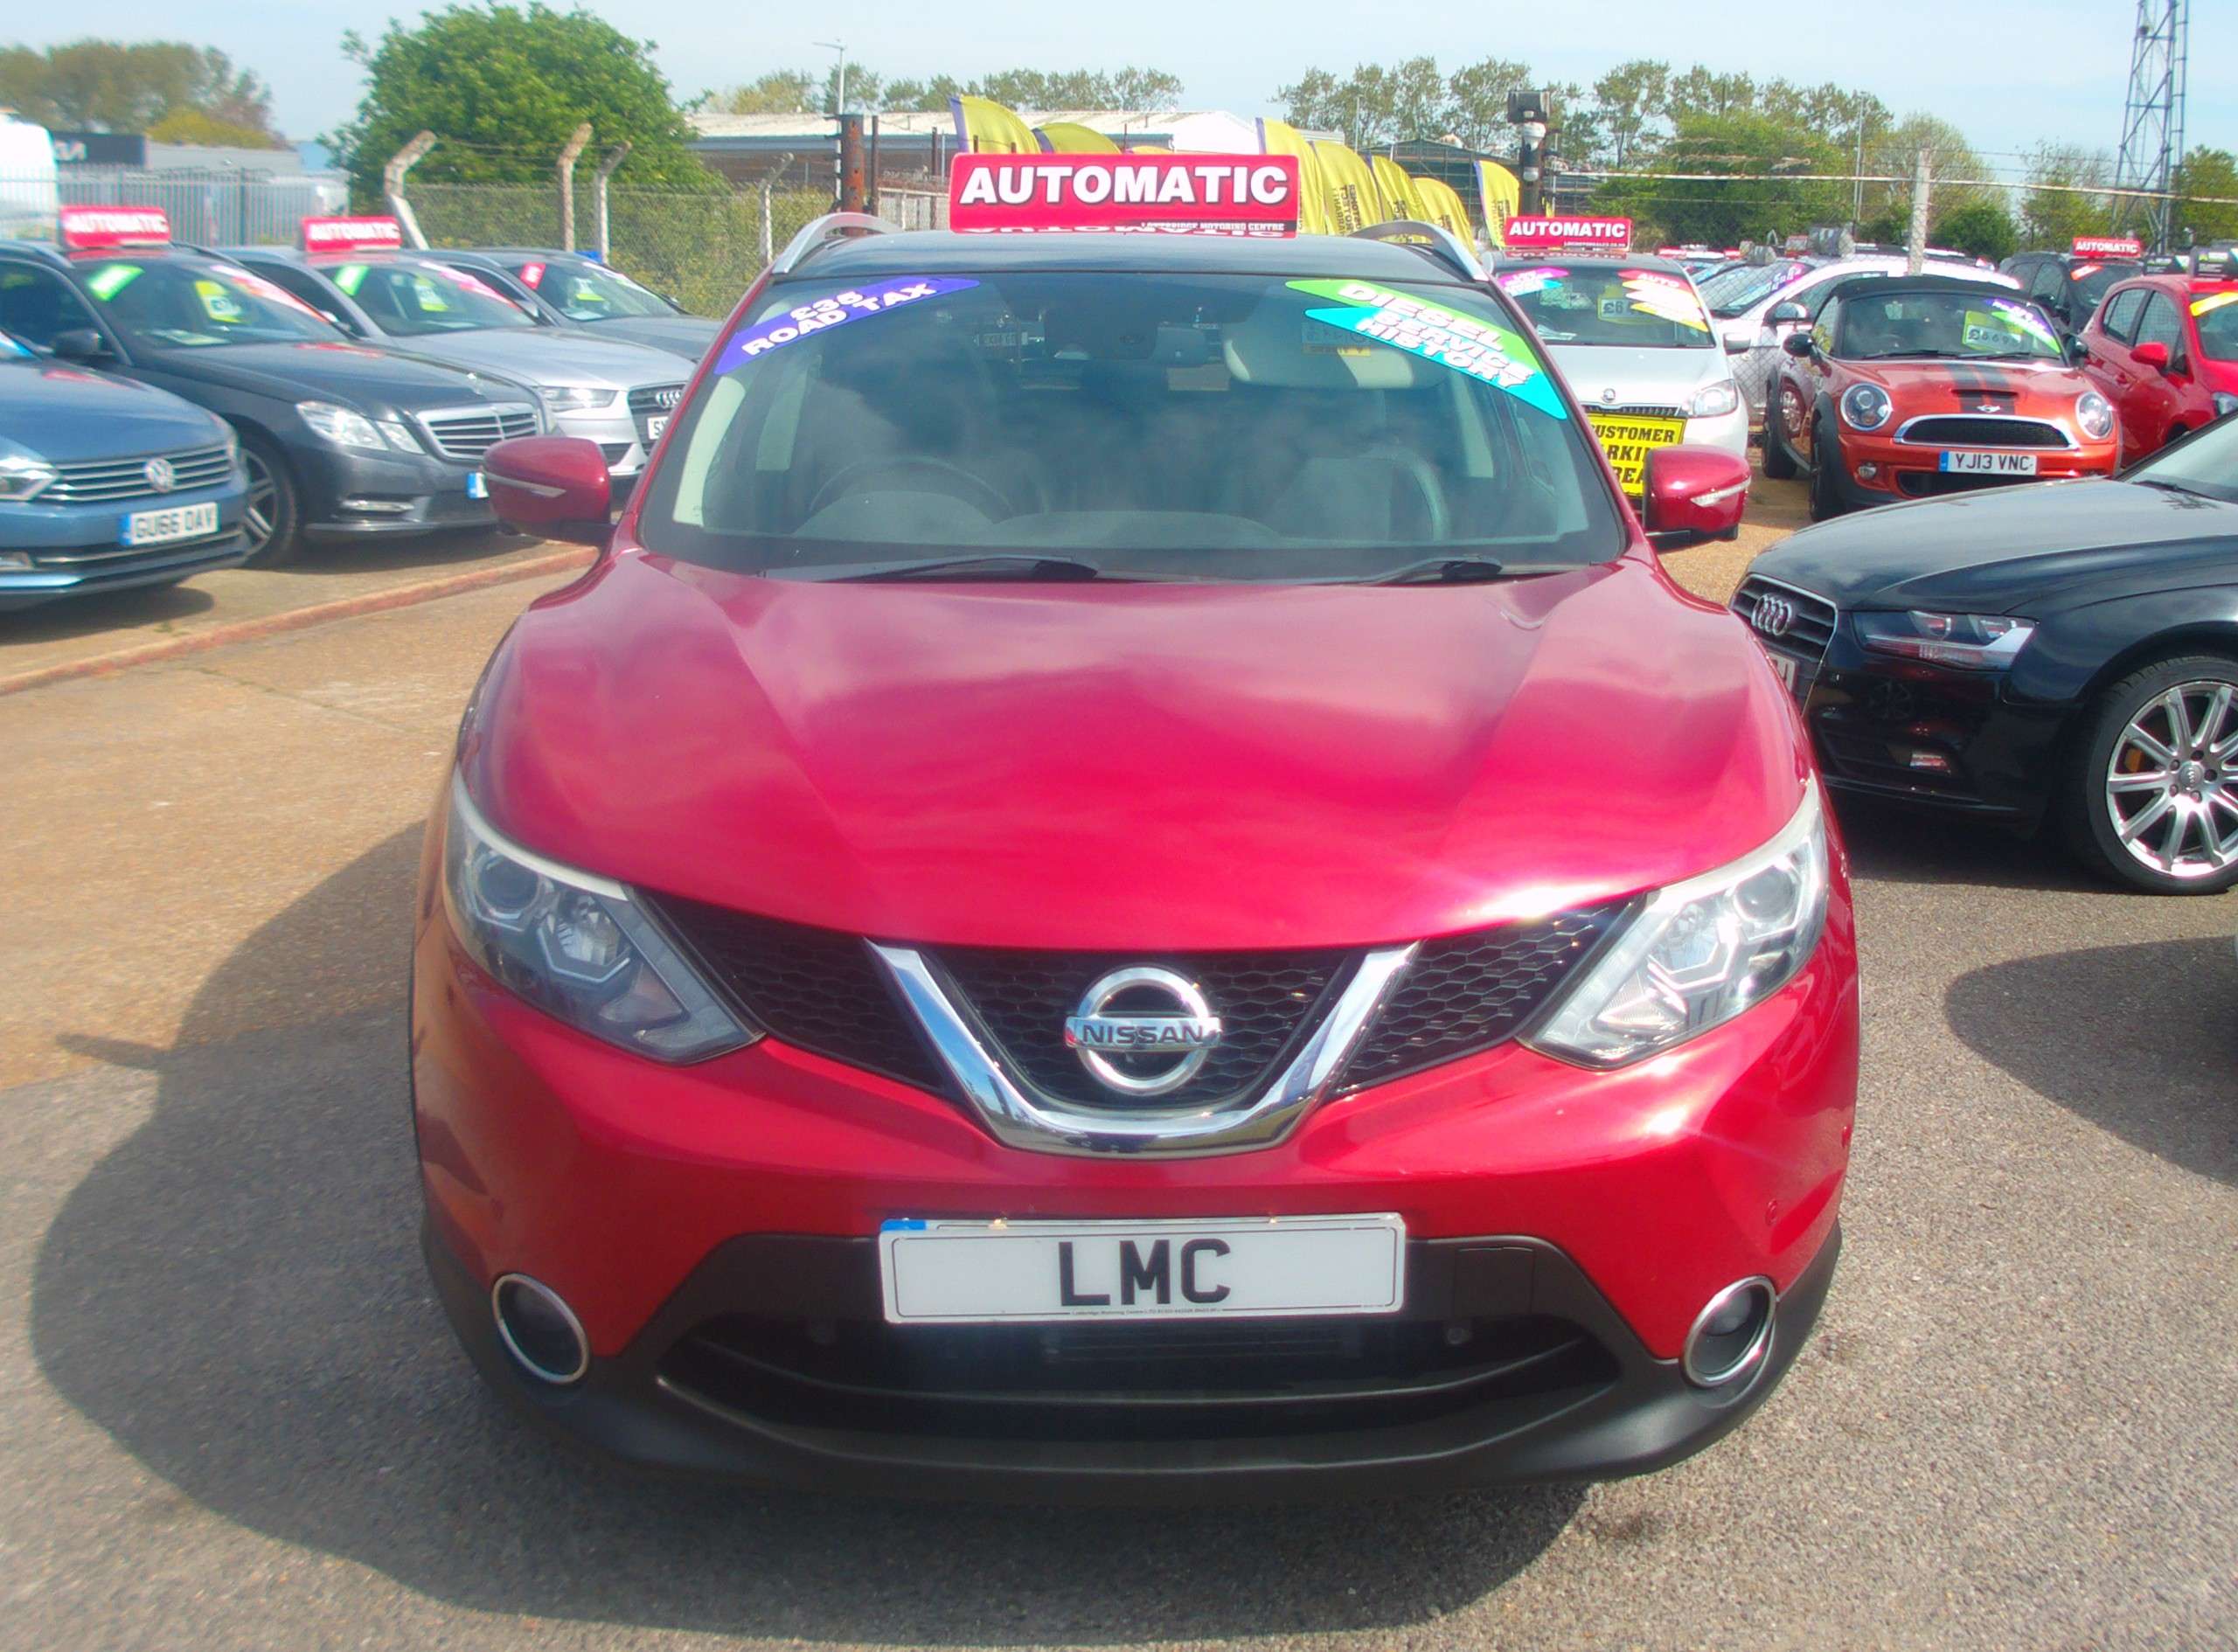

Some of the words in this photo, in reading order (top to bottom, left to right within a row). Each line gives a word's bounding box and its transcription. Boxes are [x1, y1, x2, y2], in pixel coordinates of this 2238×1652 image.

[959, 165, 1288, 205] AUTOMATIC
[64, 212, 168, 233] AUTOMATIC
[309, 222, 400, 240] AUTOMATIC
[1248, 223, 1285, 232] CENTRE
[1509, 221, 1626, 238] AUTOMATIC
[2075, 240, 2139, 253] AUTOMATIC
[741, 309, 847, 356] ROAD
[852, 282, 937, 312] TAX
[1338, 282, 1504, 351] DIESEL
[1355, 317, 1528, 388] HISTORY
[1373, 309, 1533, 383] SERVICE
[1955, 453, 1992, 469] YJ13
[1998, 455, 2030, 470] VNC
[1082, 1024, 1204, 1045] NISSAN
[1058, 1238, 1231, 1307] LMC
